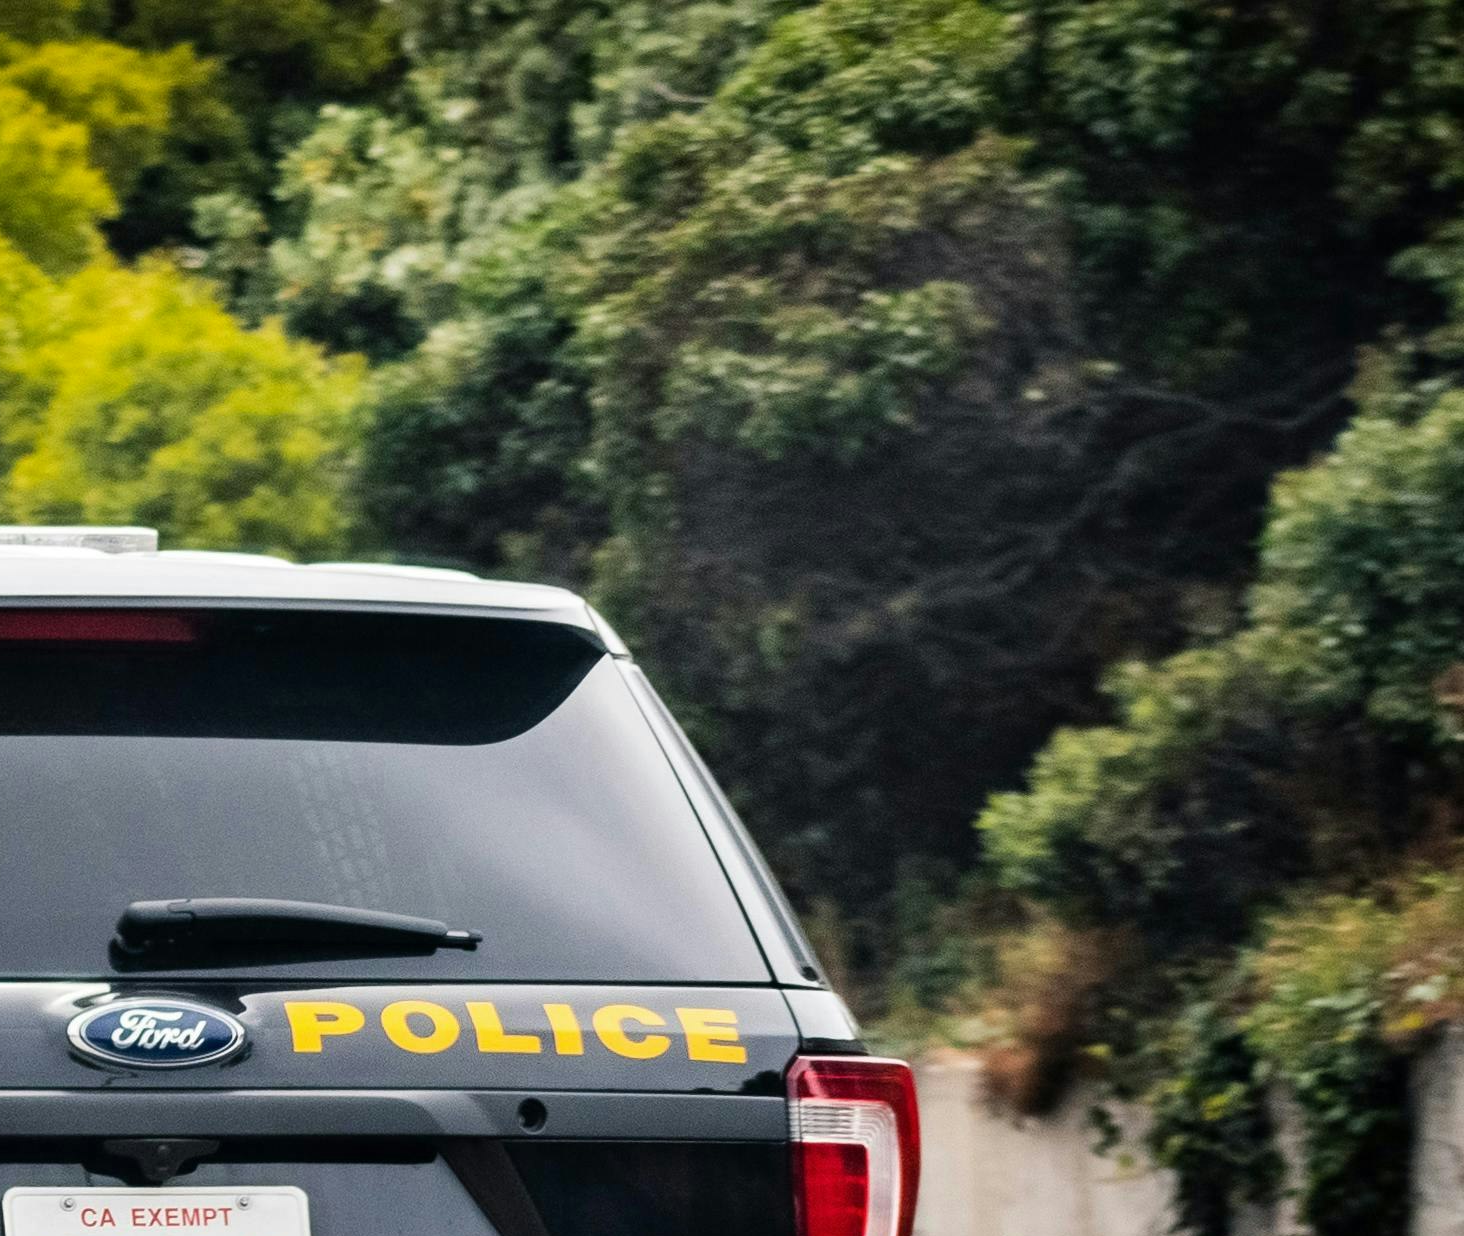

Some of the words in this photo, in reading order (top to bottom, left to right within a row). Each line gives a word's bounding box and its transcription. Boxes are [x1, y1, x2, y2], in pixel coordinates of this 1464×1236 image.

[111, 1008, 207, 1050] Ford
[283, 1000, 747, 1065] POLICE
[80, 1207, 117, 1228] CA
[130, 1206, 234, 1228] EXEMPT
